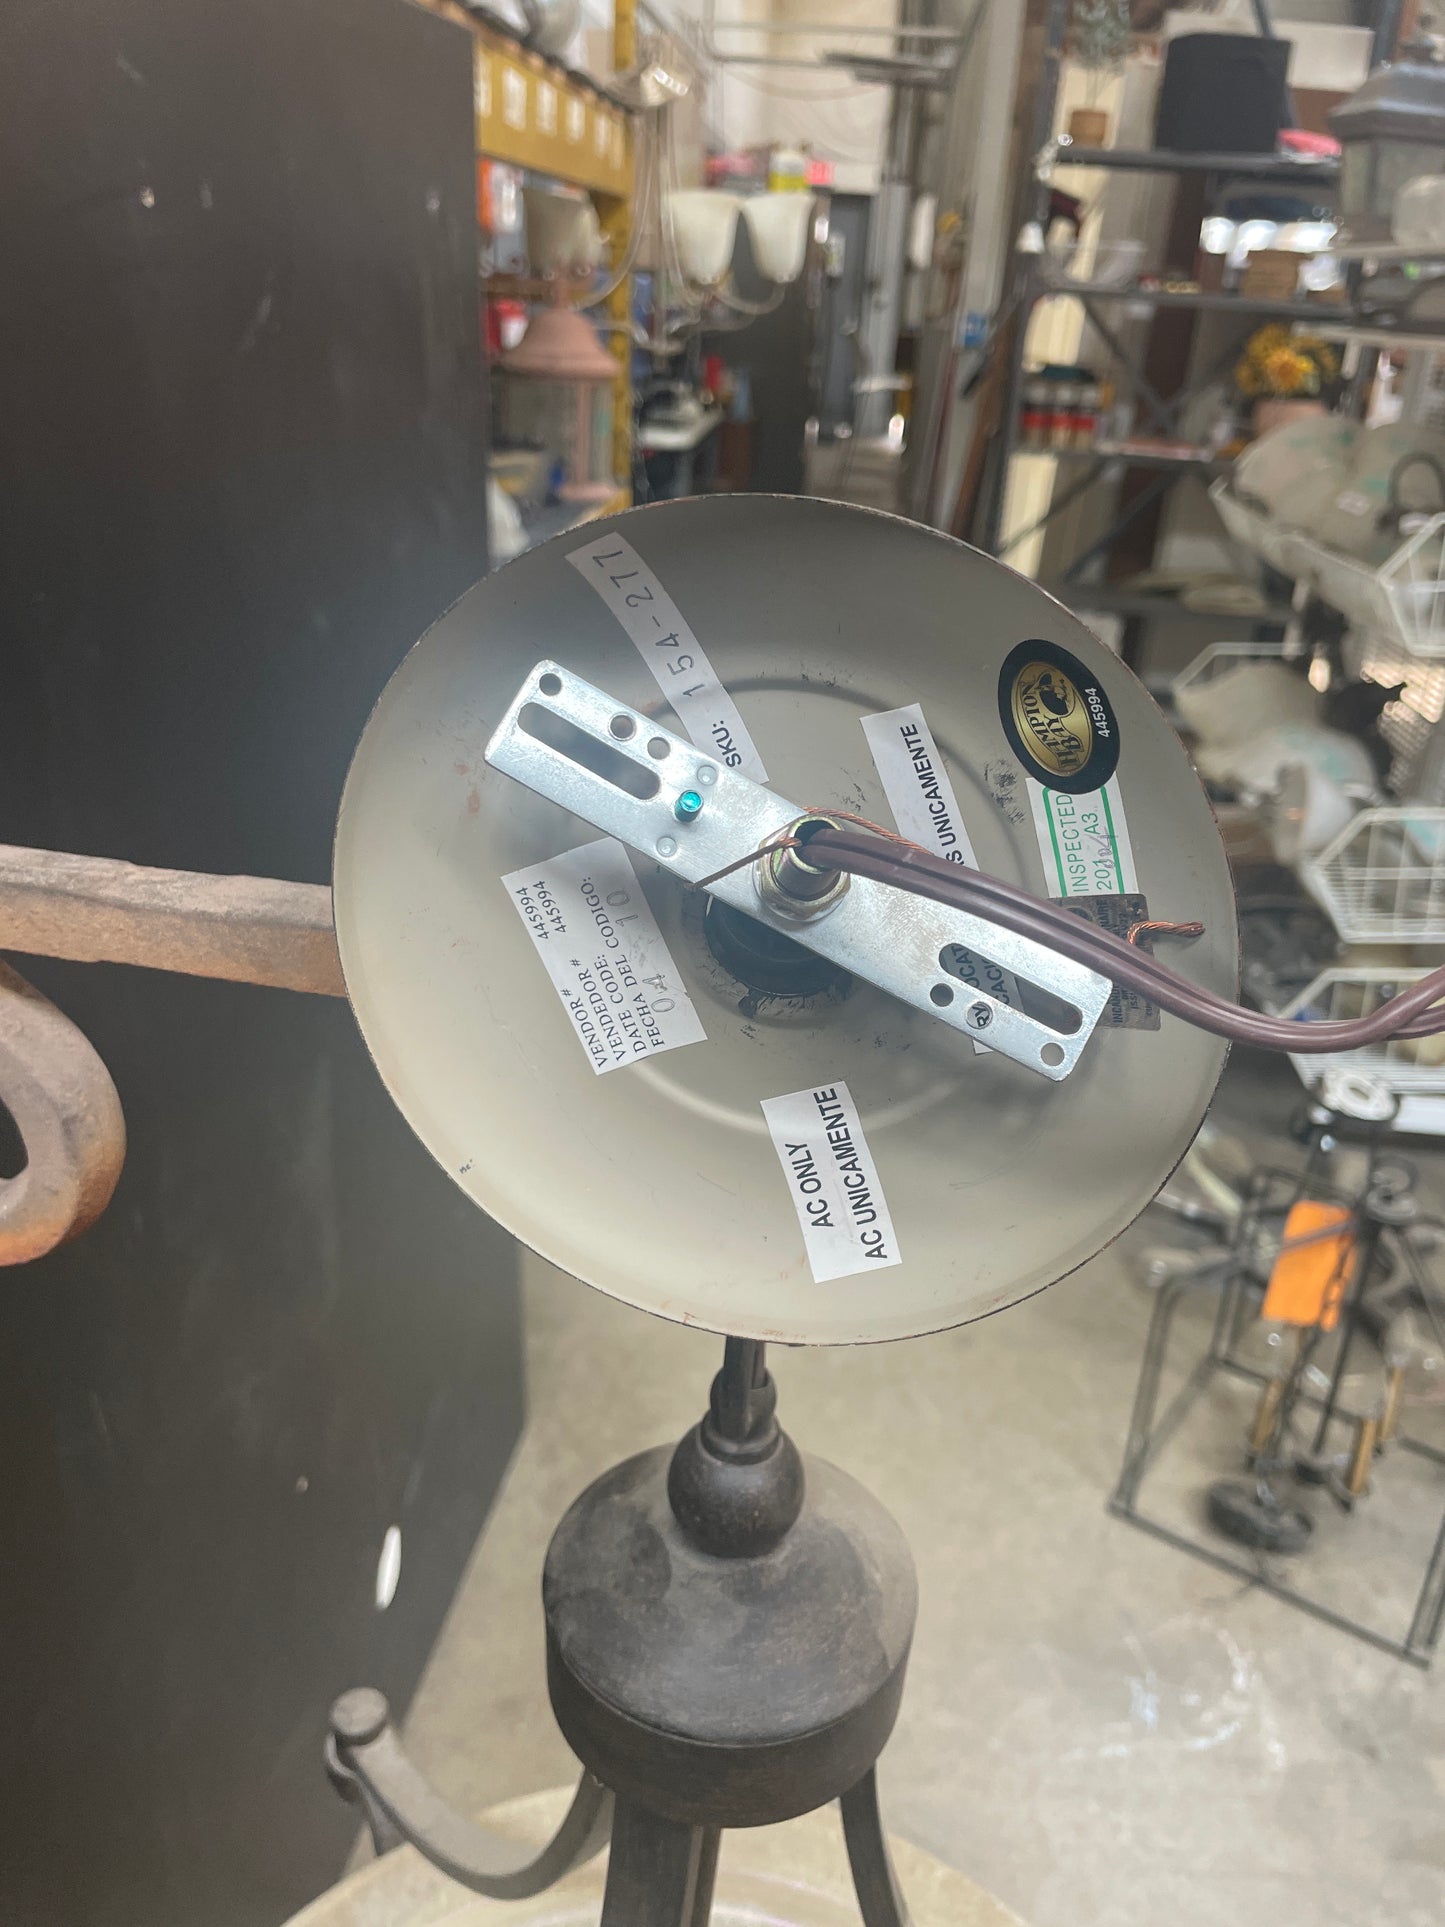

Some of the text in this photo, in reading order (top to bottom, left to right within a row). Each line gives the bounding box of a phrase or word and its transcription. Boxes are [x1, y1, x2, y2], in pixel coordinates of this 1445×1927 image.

[712, 720, 742, 768] SKU:
[1020, 682, 1081, 768] HAMPTON
[1044, 714, 1083, 754] BAY
[1085, 687, 1111, 738] 445994
[900, 724, 957, 847] UNICAMENTE
[1056, 794, 1090, 893] INSPECTED
[515, 887, 608, 1068] VENDOR # 445994
[532, 880, 627, 1062] VENDEDOR # 445994
[580, 876, 665, 1048] FECHA DEL CODIGO:
[594, 954, 647, 1054] DATE CODE:
[971, 1005, 991, 1028] RY
[784, 1143, 834, 1228] AC ONLY
[813, 1087, 888, 1259] AC UNICAMENTE
